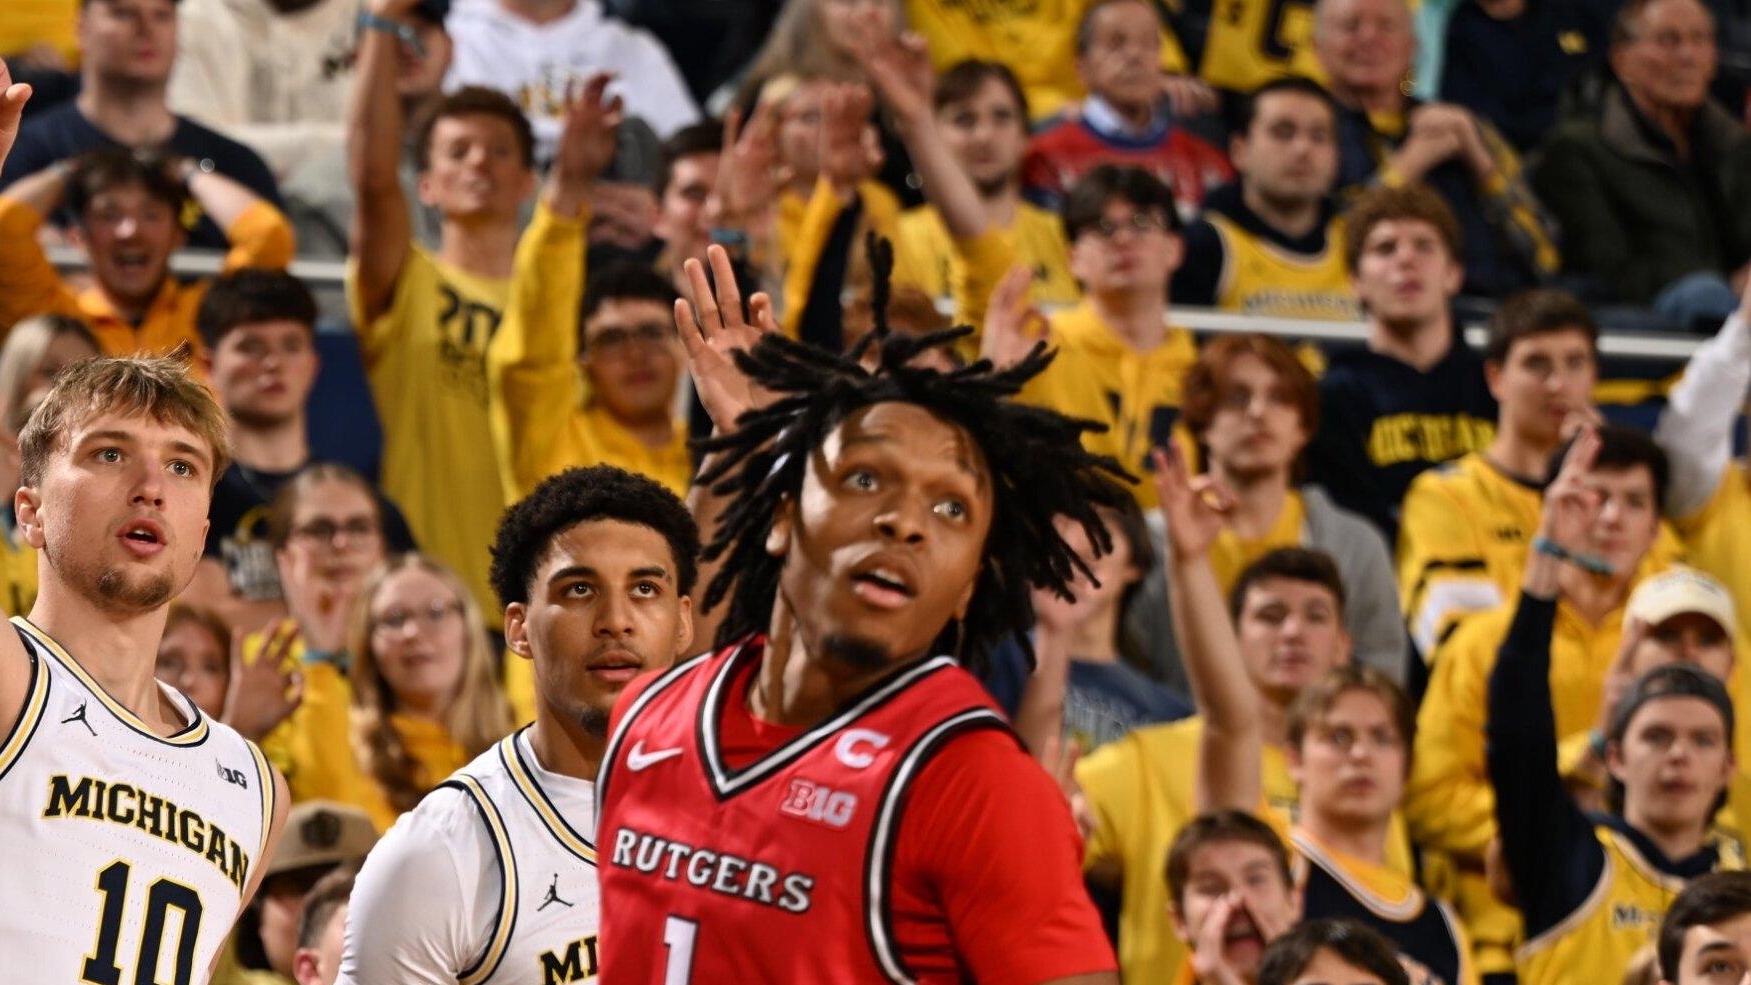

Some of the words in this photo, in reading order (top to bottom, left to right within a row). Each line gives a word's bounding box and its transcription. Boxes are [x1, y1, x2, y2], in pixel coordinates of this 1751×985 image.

[835, 729, 891, 769] C
[41, 774, 249, 898] MICHIGAN
[611, 826, 815, 915] RUTGERS
